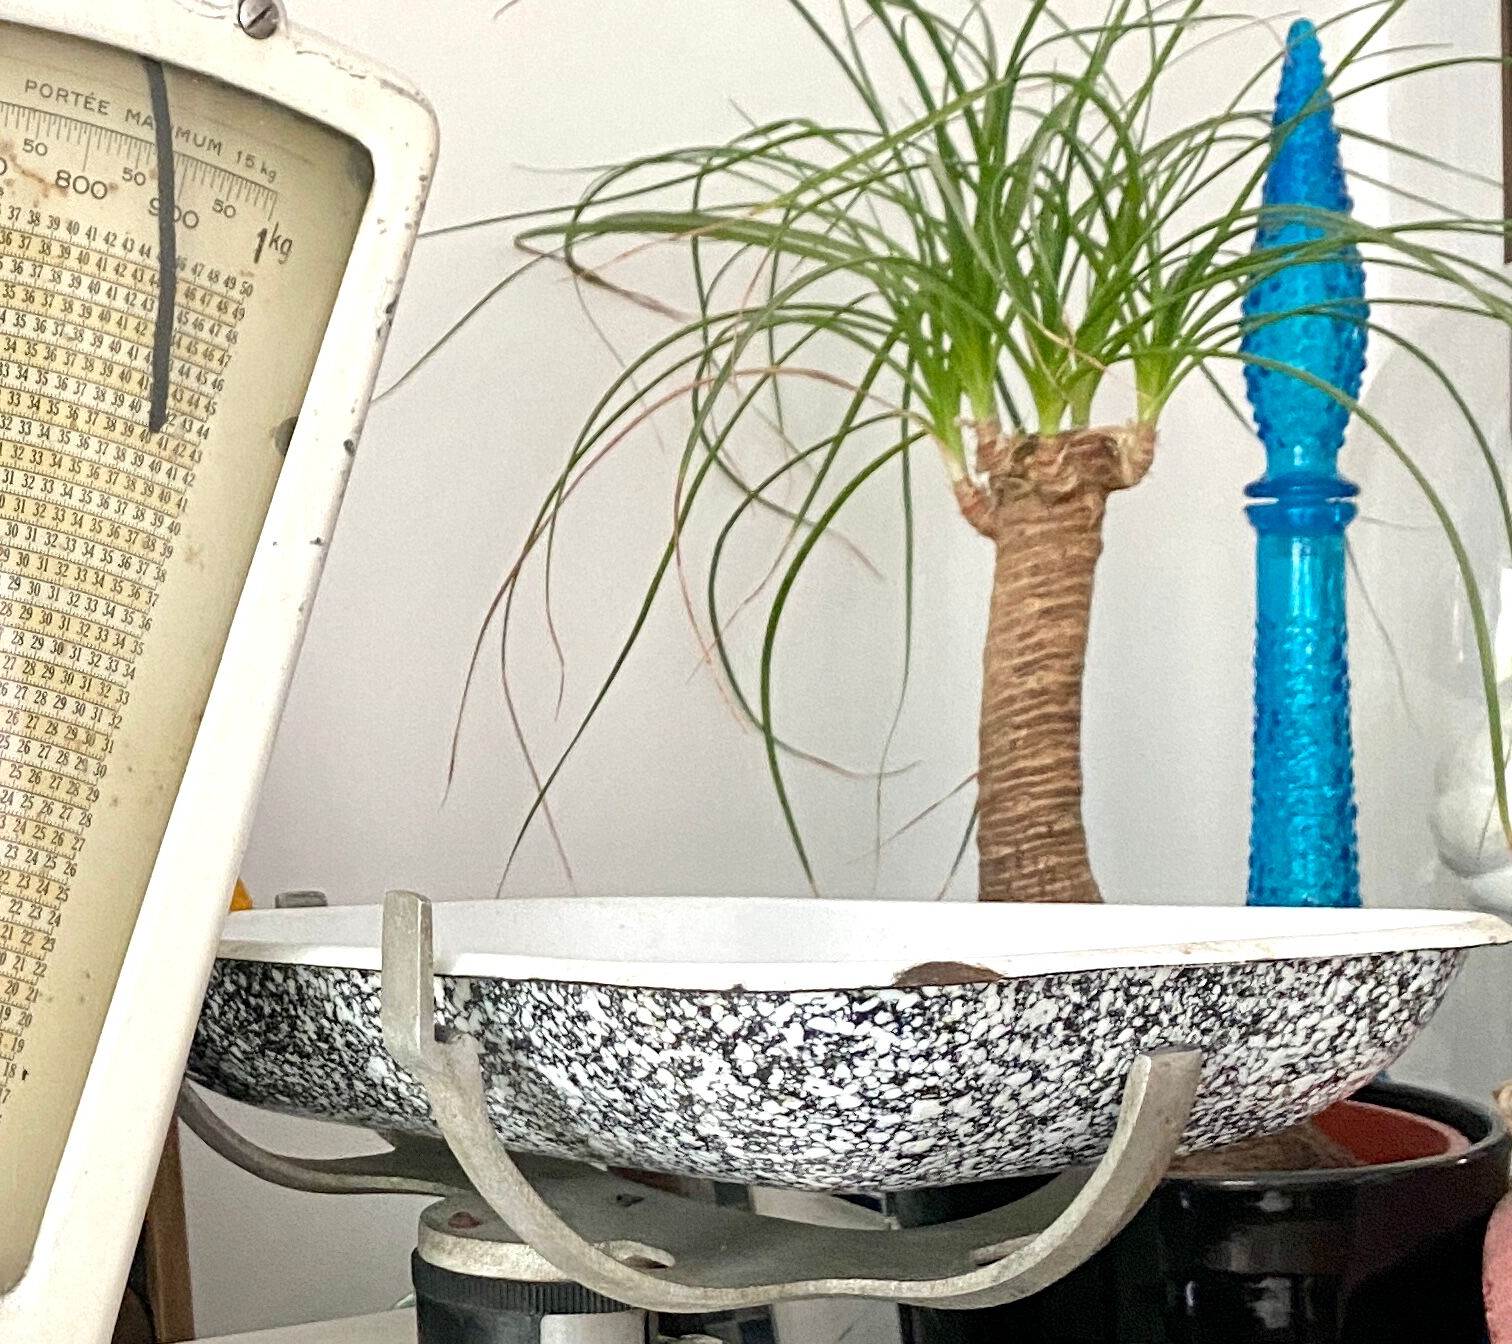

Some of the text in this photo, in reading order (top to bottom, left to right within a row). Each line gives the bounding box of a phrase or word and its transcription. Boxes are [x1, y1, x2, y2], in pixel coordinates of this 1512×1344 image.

[24, 79, 277, 183] PORTÉE MAMUM 15 kg
[22, 138, 48, 156] 50
[55, 170, 108, 200] 800
[121, 167, 146, 186] 50
[212, 198, 237, 219] 50
[7, 205, 21, 221] 37
[27, 210, 41, 226] 38
[47, 215, 61, 231] 39
[66, 220, 80, 236] 40
[85, 225, 98, 242] 41
[103, 231, 117, 247] 42
[122, 237, 135, 253] 43
[138, 242, 152, 259] 44
[191, 262, 205, 277] 47
[207, 269, 221, 284] 48
[223, 274, 237, 289] 49
[239, 281, 254, 297] 50
